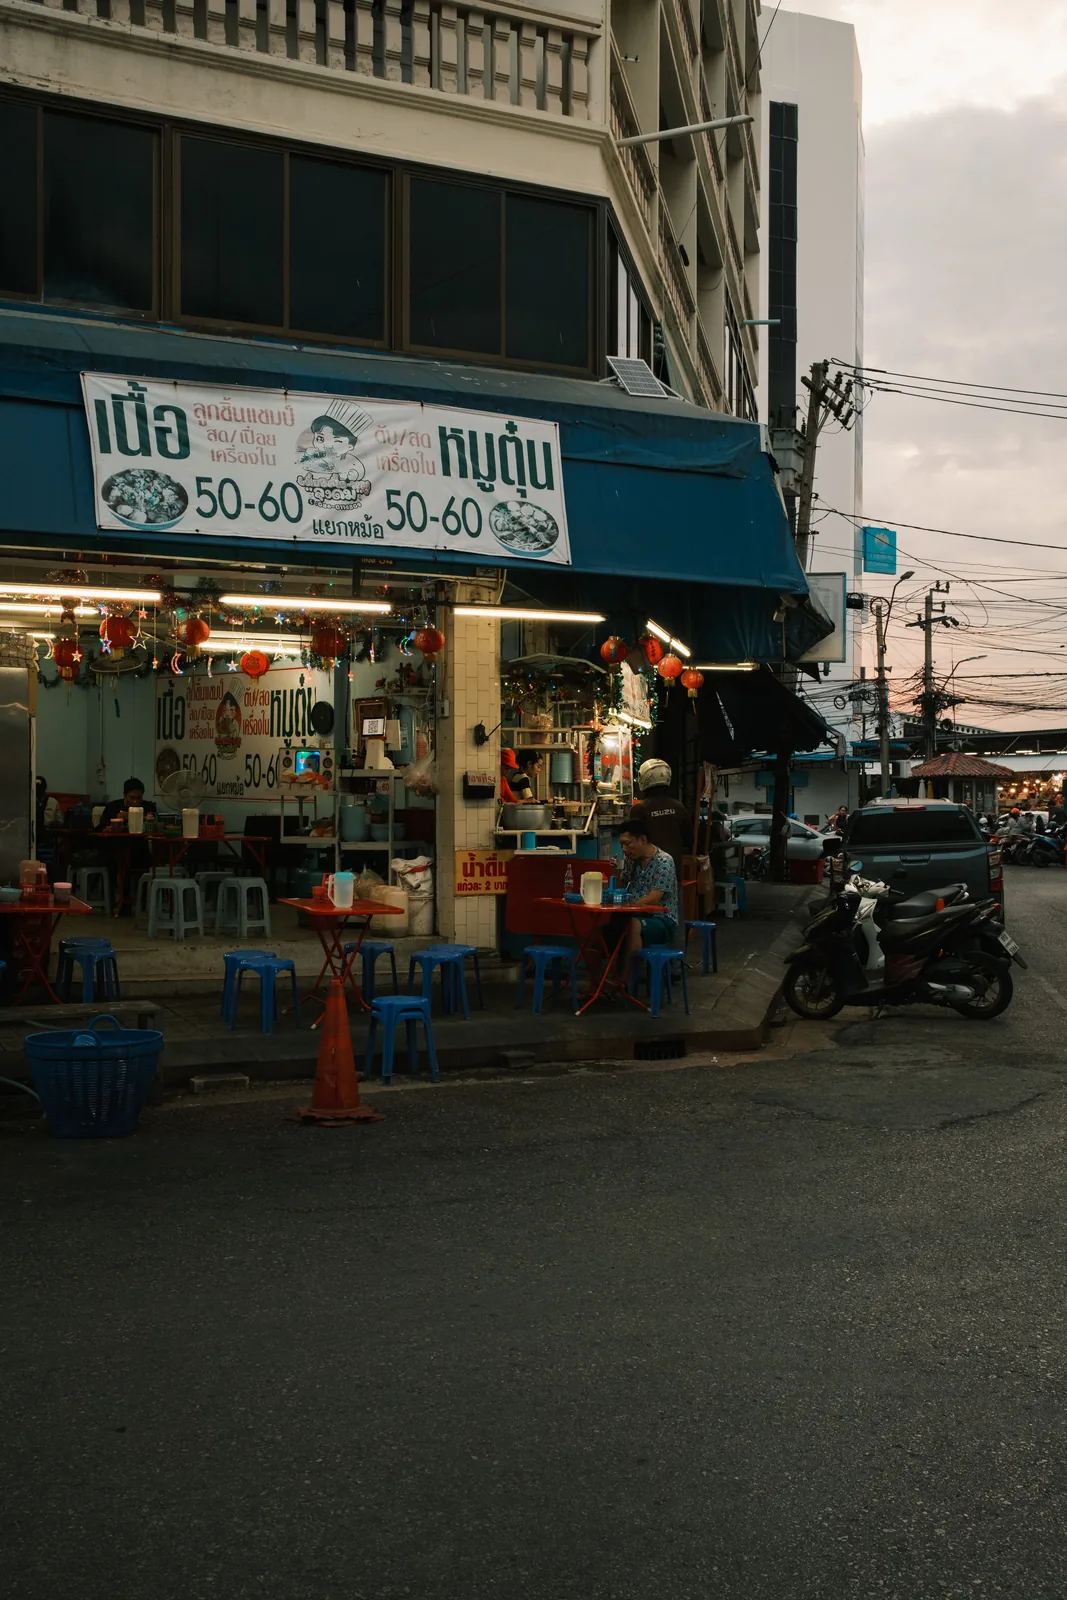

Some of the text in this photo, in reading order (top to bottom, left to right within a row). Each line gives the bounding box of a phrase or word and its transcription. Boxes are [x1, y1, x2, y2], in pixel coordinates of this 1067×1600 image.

[94, 381, 191, 460] เนื้อ
[193, 397, 295, 427] ลูกชิ้นแชมป์
[210, 444, 277, 466] เครื่องใน
[375, 448, 436, 475] เครื่องใน
[438, 421, 555, 498] หมูตุ๋น
[195, 476, 303, 524] 50-60
[386, 489, 482, 539] 50-60
[312, 514, 384, 539] แยกหม้อ
[156, 680, 186, 740] เนื้อ
[651, 808, 676, 818] ISUZU
[485, 880, 491, 891] 2
